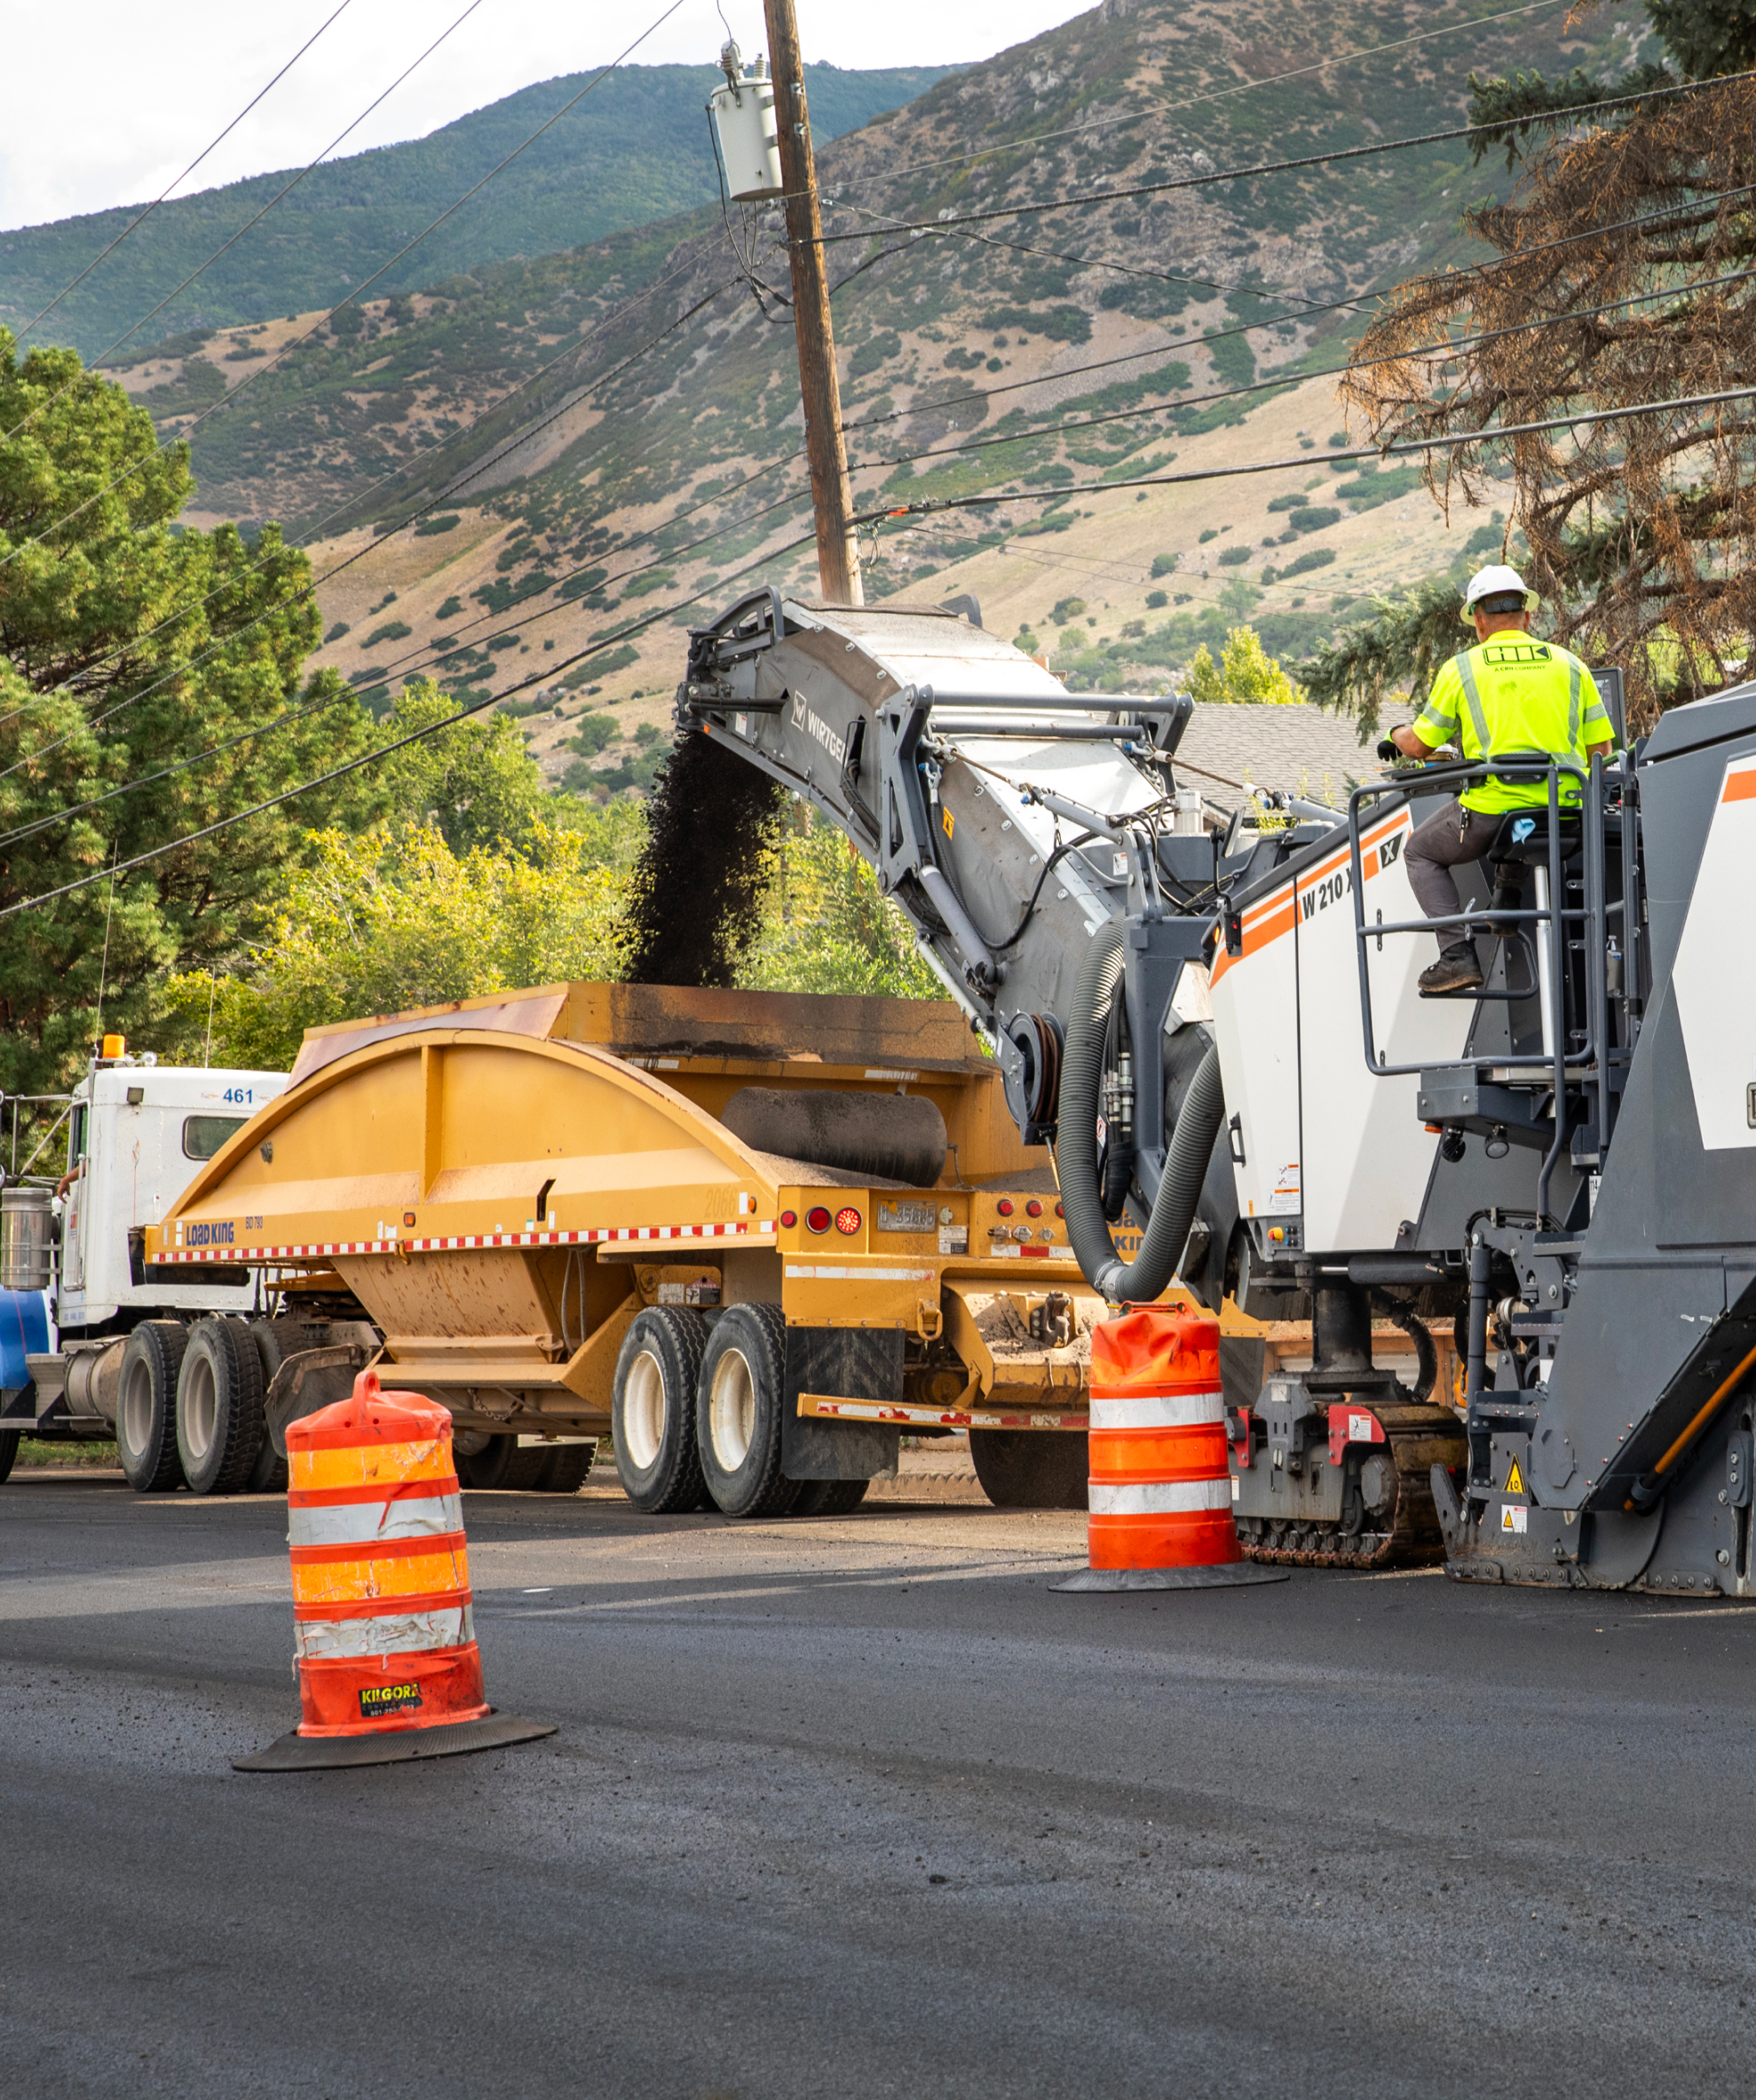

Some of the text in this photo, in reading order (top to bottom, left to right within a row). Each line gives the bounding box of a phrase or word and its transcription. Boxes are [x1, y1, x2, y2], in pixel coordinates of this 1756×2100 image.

[1302, 889, 1316, 920] W
[1318, 873, 1343, 911] 210
[223, 1088, 252, 1104] 461
